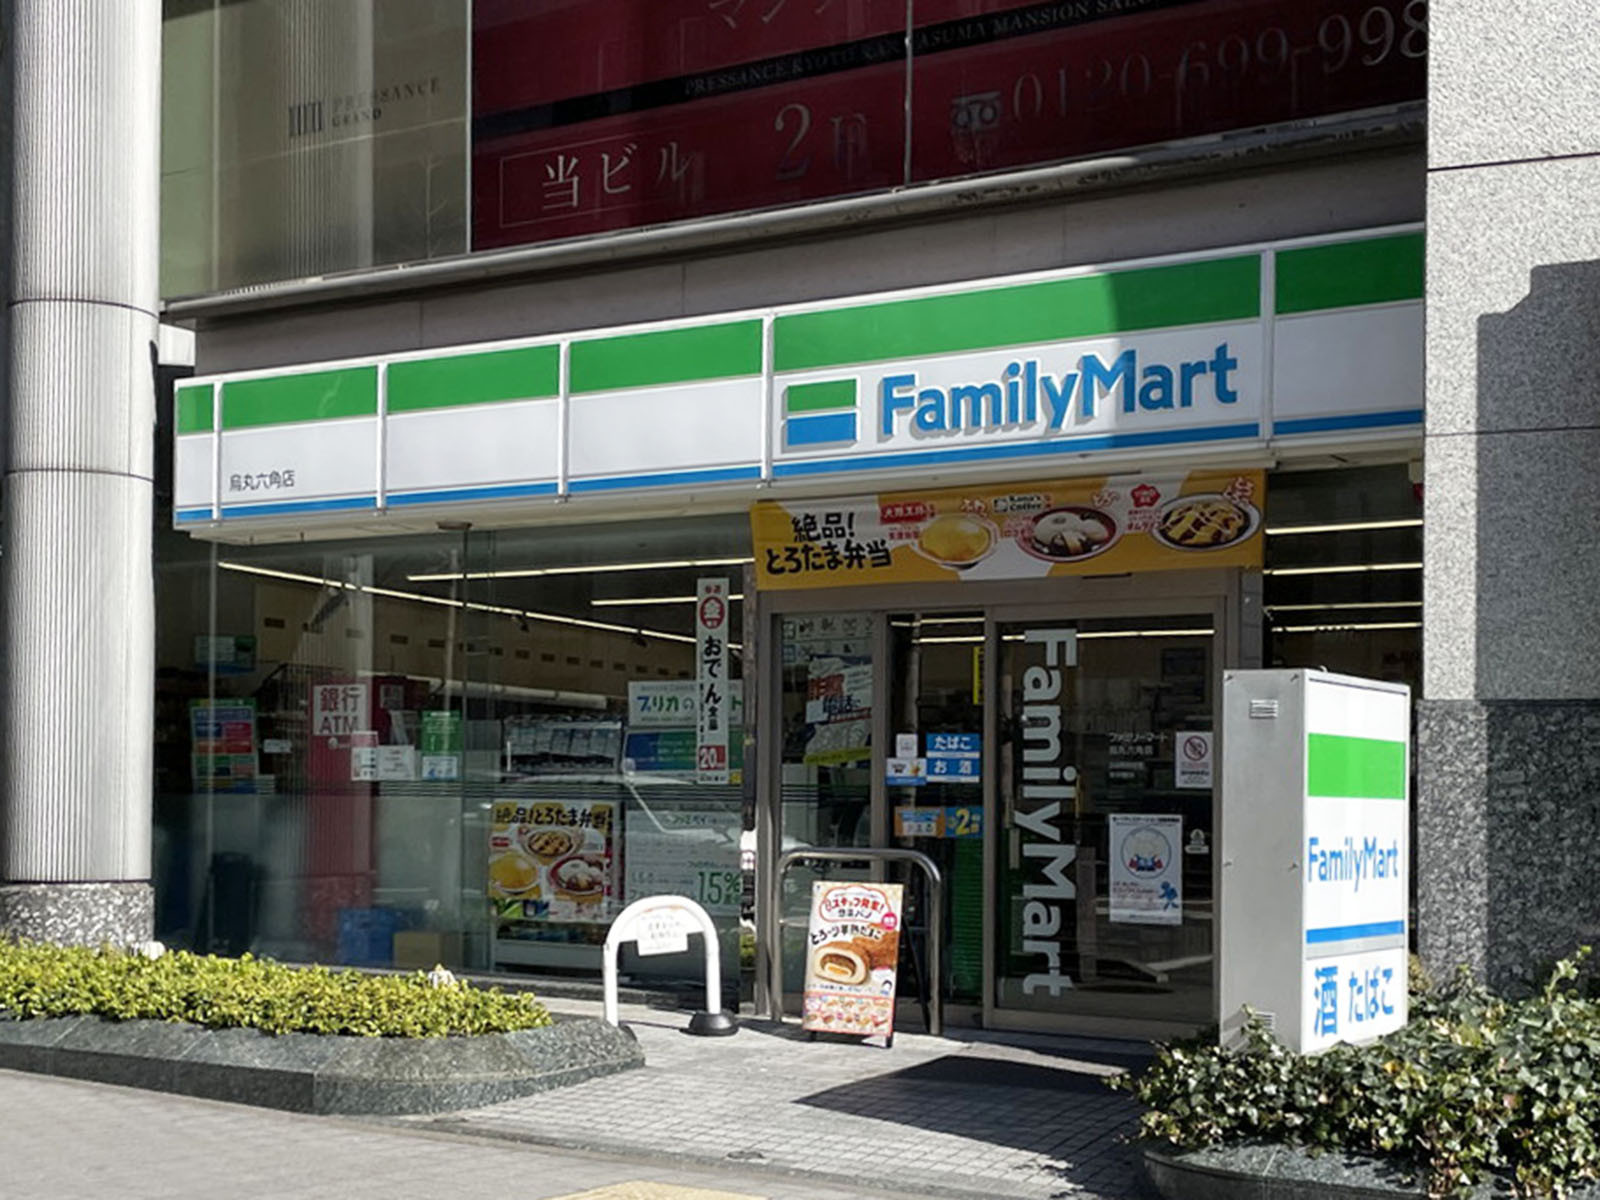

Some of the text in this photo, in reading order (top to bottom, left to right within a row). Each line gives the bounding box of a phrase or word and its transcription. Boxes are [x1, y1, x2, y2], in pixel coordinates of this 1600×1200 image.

[881, 343, 1237, 436] FamilyMart
[766, 539, 892, 575] とろたま弁当
[1014, 629, 1077, 997] FamilyMart
[1309, 837, 1398, 892] FamilyMart
[1314, 965, 1394, 1037] 酒 たばこ
